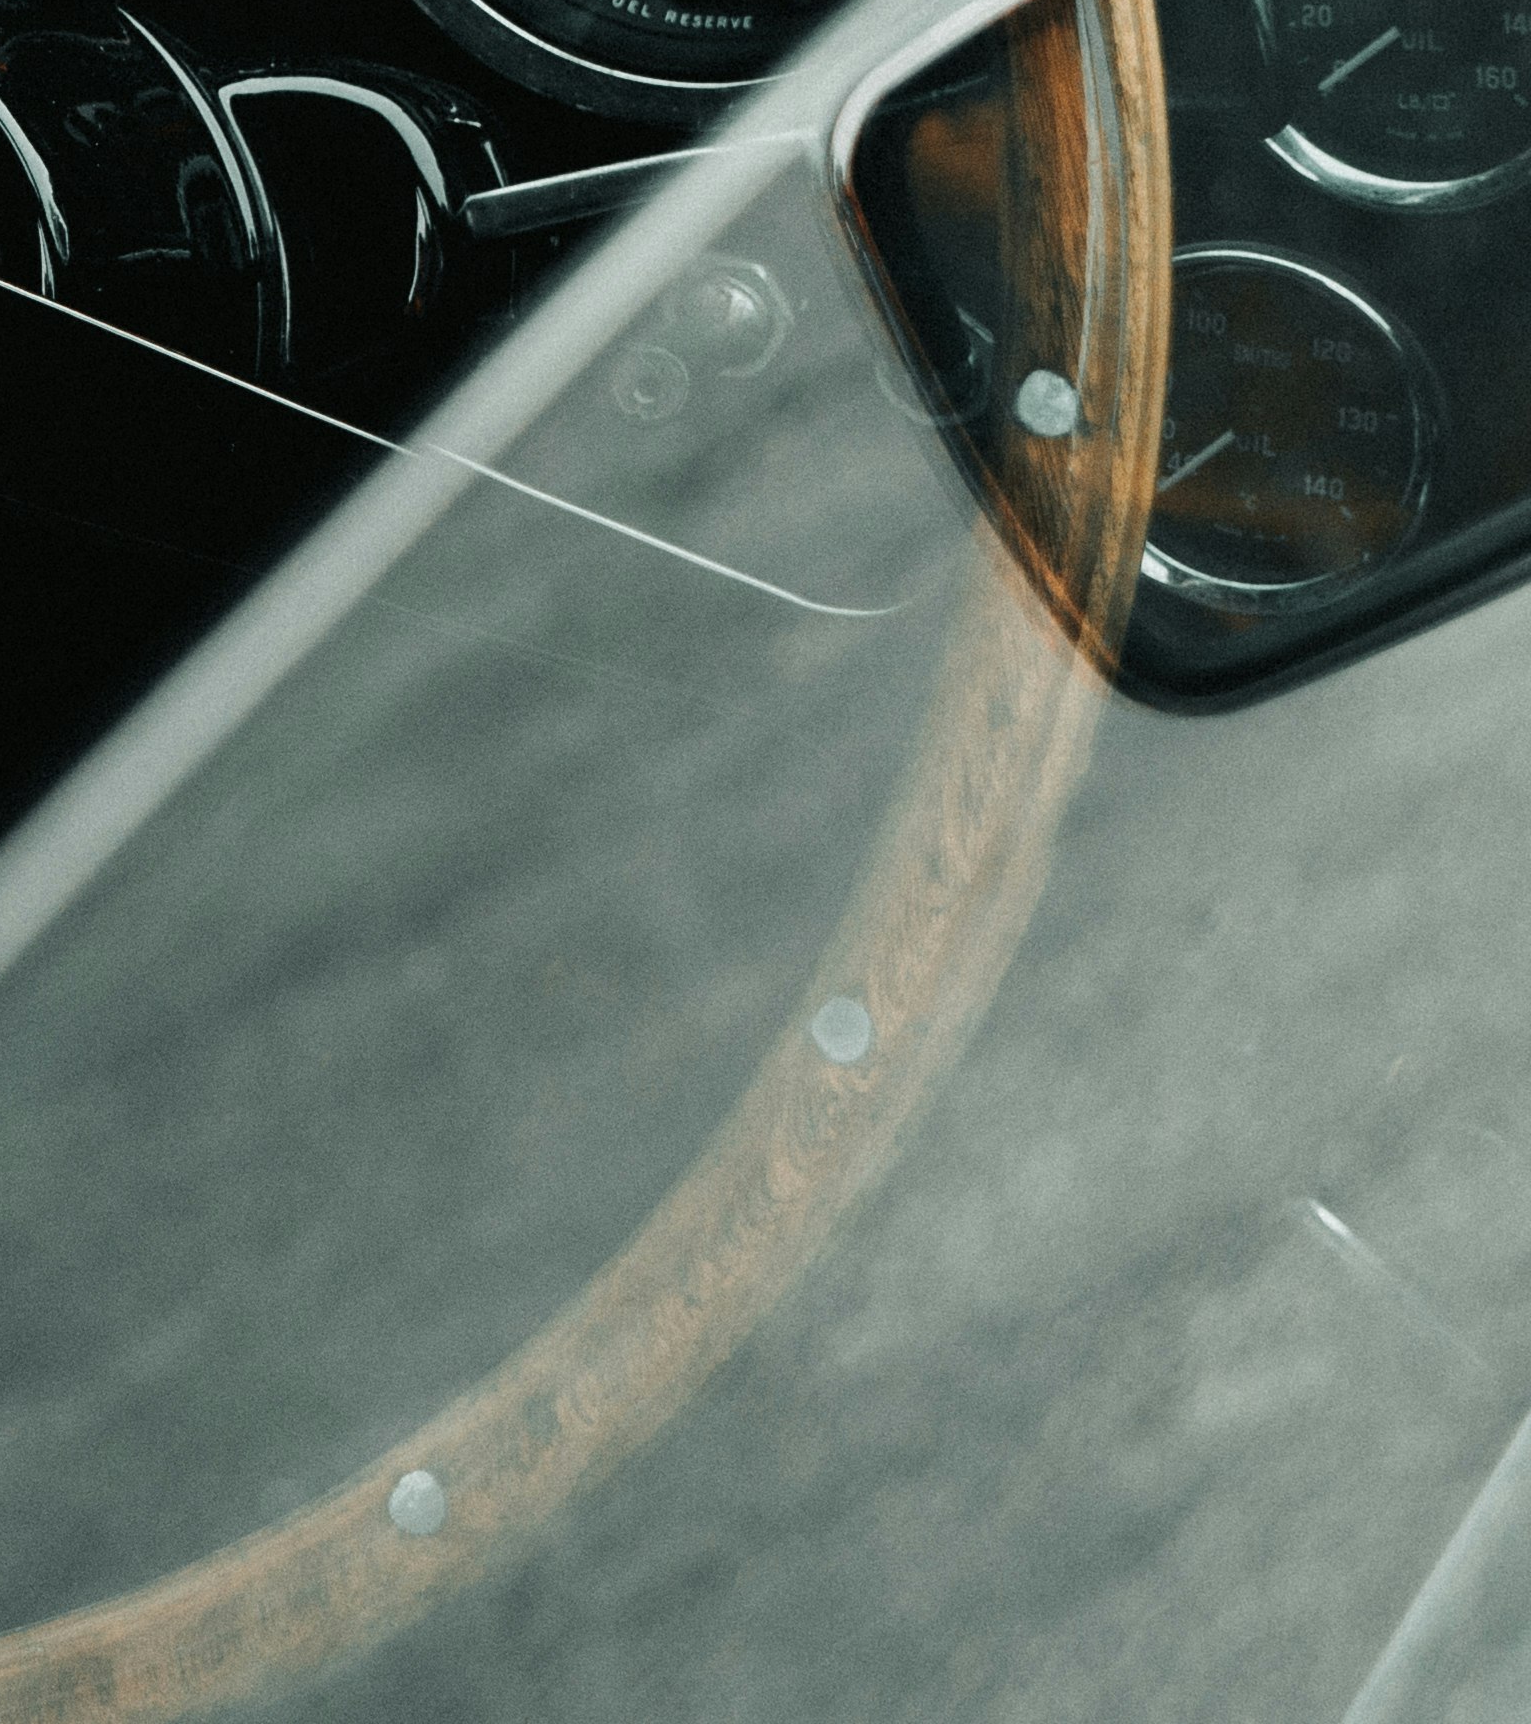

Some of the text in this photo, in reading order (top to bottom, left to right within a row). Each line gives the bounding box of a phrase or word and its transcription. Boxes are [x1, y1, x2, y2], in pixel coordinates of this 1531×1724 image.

[664, 8, 754, 31] RESERVE
[1301, 4, 1333, 28] 20
[1400, 29, 1446, 52] OIL
[1475, 64, 1517, 90] 160
[1186, 308, 1228, 335] 100
[1337, 406, 1380, 434] 130
[1302, 474, 1346, 501] 140
